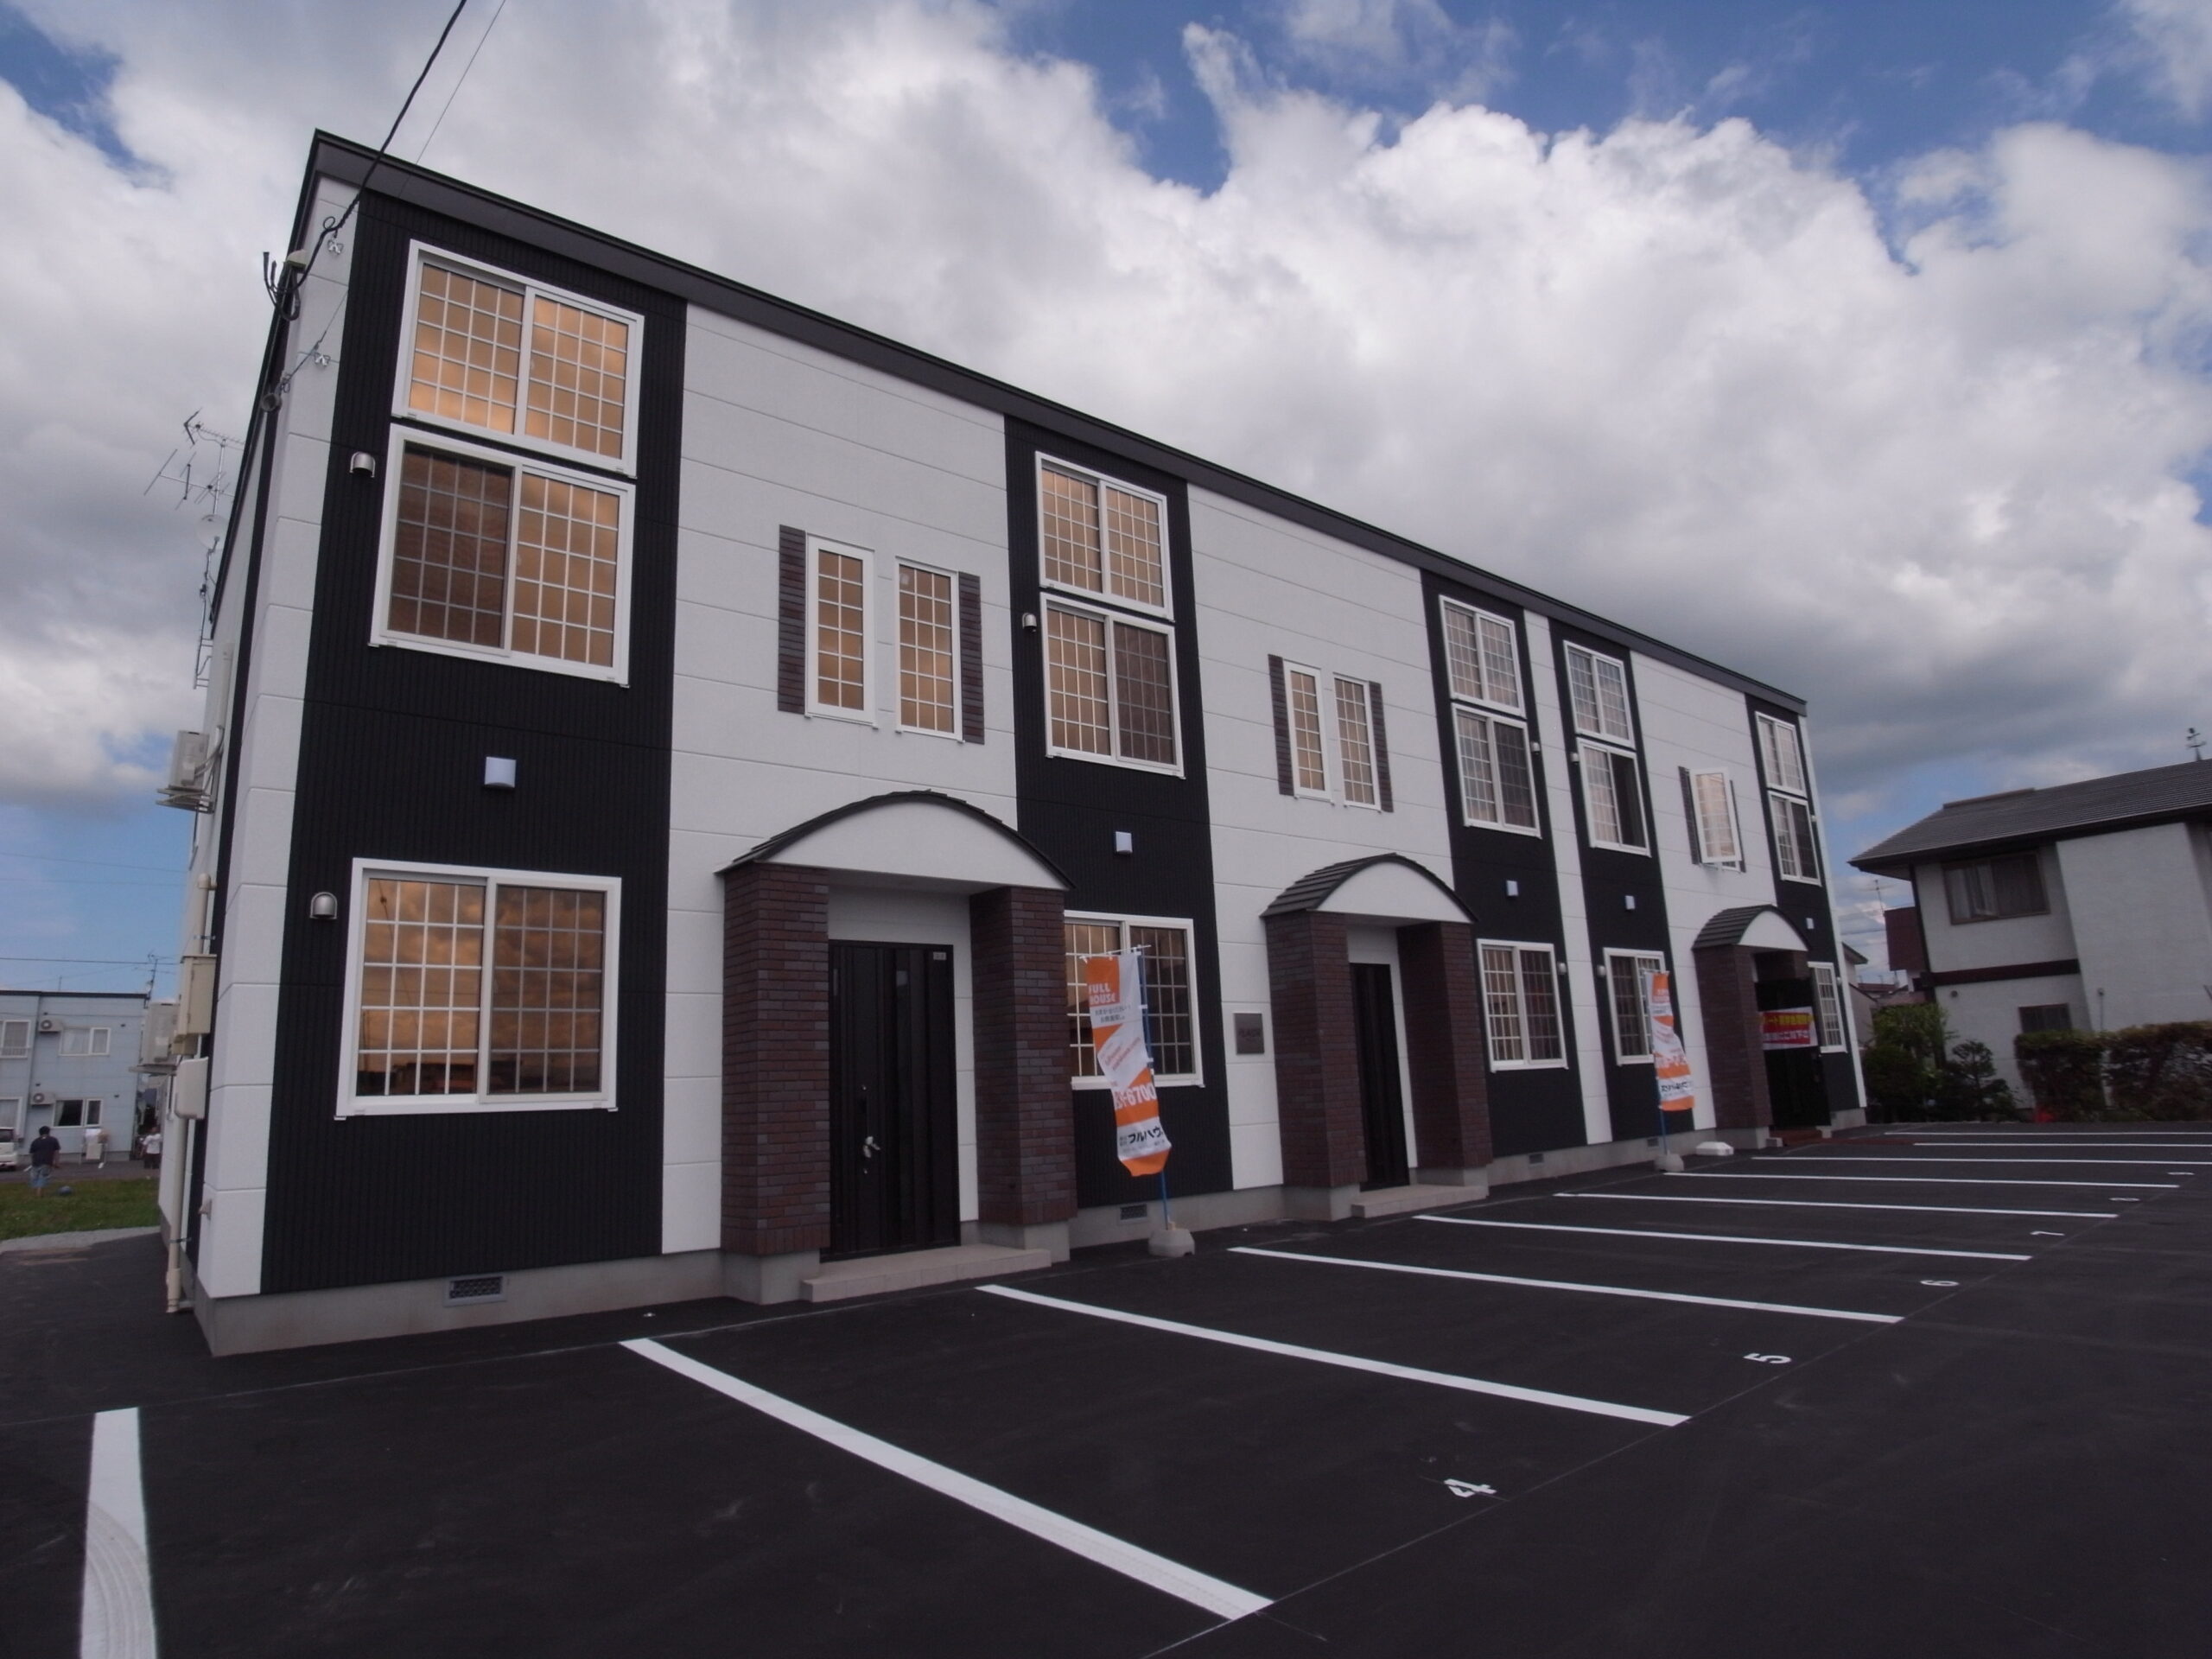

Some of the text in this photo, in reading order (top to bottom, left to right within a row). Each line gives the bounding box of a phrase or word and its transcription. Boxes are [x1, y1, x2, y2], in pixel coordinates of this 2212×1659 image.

[1919, 1279, 1960, 1287] 6
[1742, 1352, 1792, 1364] 5
[1443, 1478, 1497, 1497] 4
